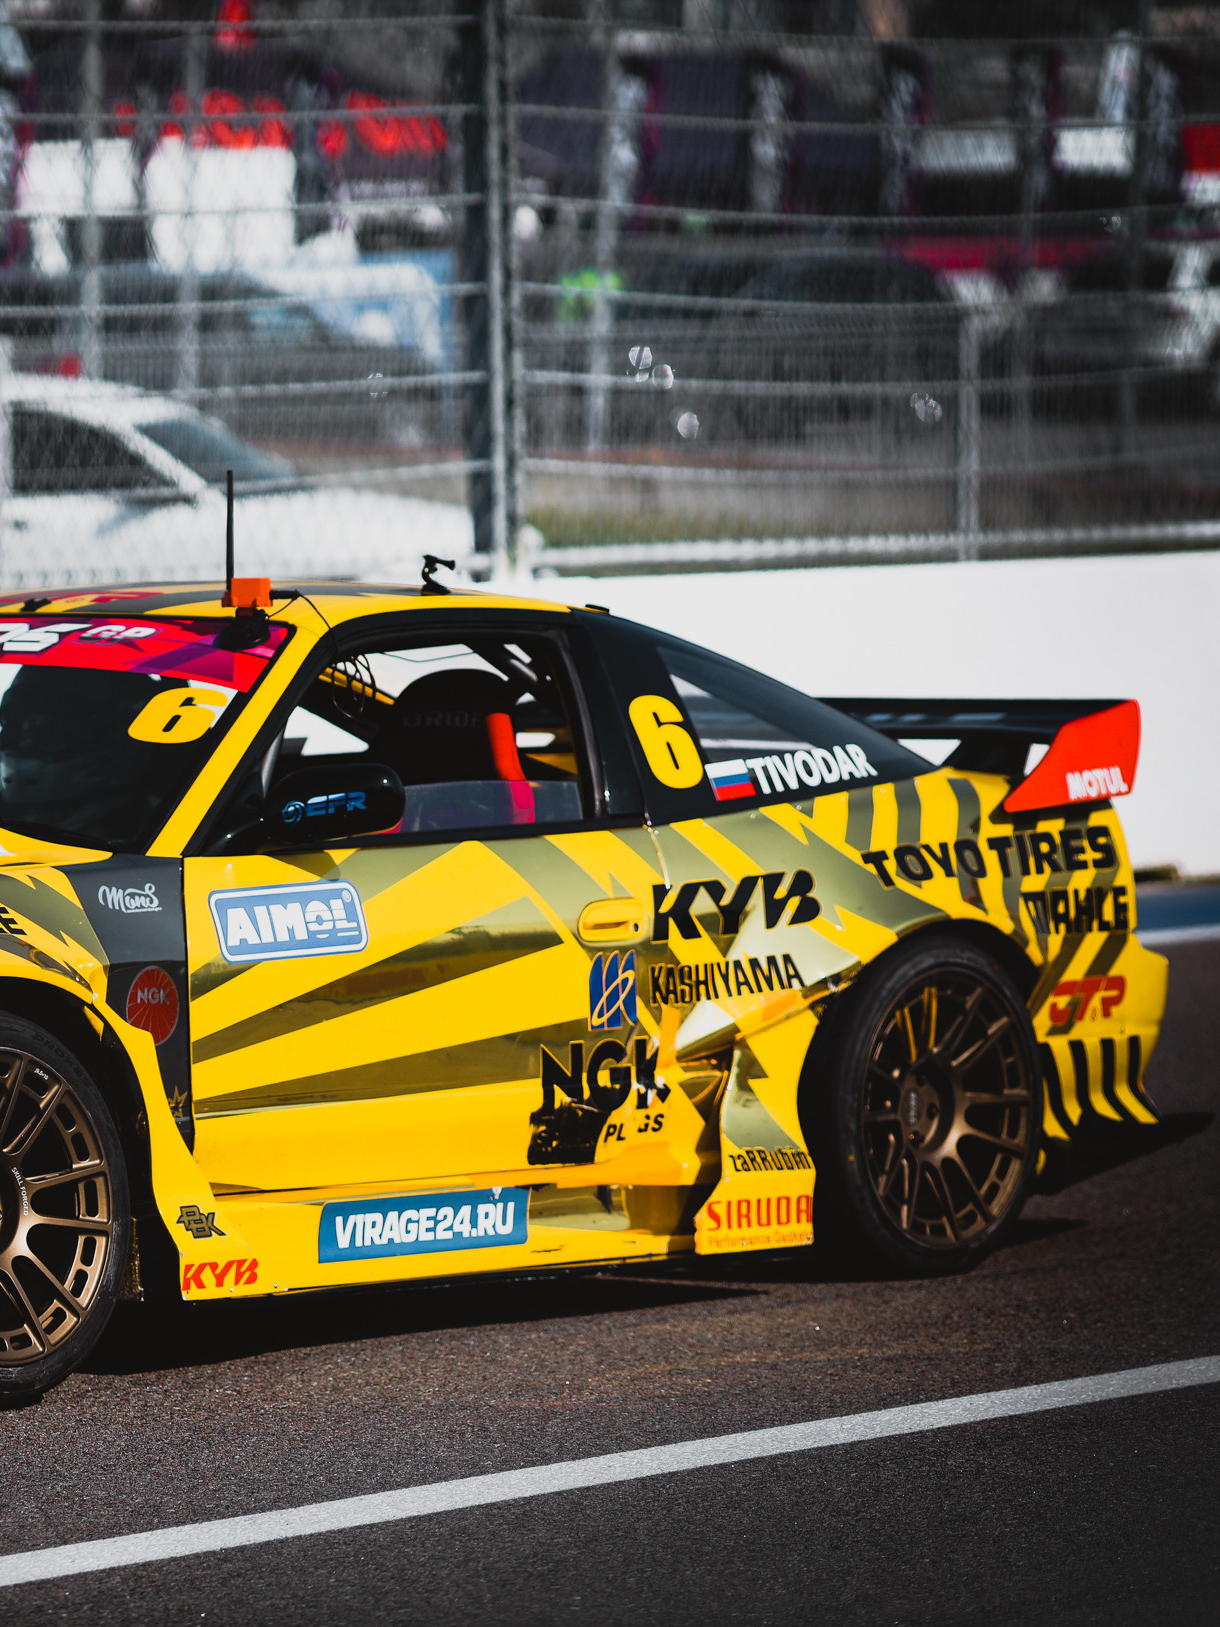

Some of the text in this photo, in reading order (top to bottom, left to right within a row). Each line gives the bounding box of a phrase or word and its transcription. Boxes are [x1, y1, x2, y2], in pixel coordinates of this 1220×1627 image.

[128, 687, 228, 744] 6
[629, 695, 704, 789] 6
[745, 743, 878, 795] TIVODAR
[1065, 766, 1129, 800] MOTUL
[305, 791, 367, 816] EFR
[861, 826, 1120, 889] TOYO TIRES
[227, 898, 359, 946] AIMOL
[652, 869, 822, 943] KYB
[1019, 886, 1129, 936] MAHLE
[137, 987, 170, 1005] NGK
[649, 953, 806, 1006] KASHIYAMA
[540, 1038, 671, 1112] NGK
[334, 1201, 515, 1249] VIRAGE24.RU
[707, 1194, 813, 1231] SIRUDA
[182, 1258, 259, 1291] KYB
